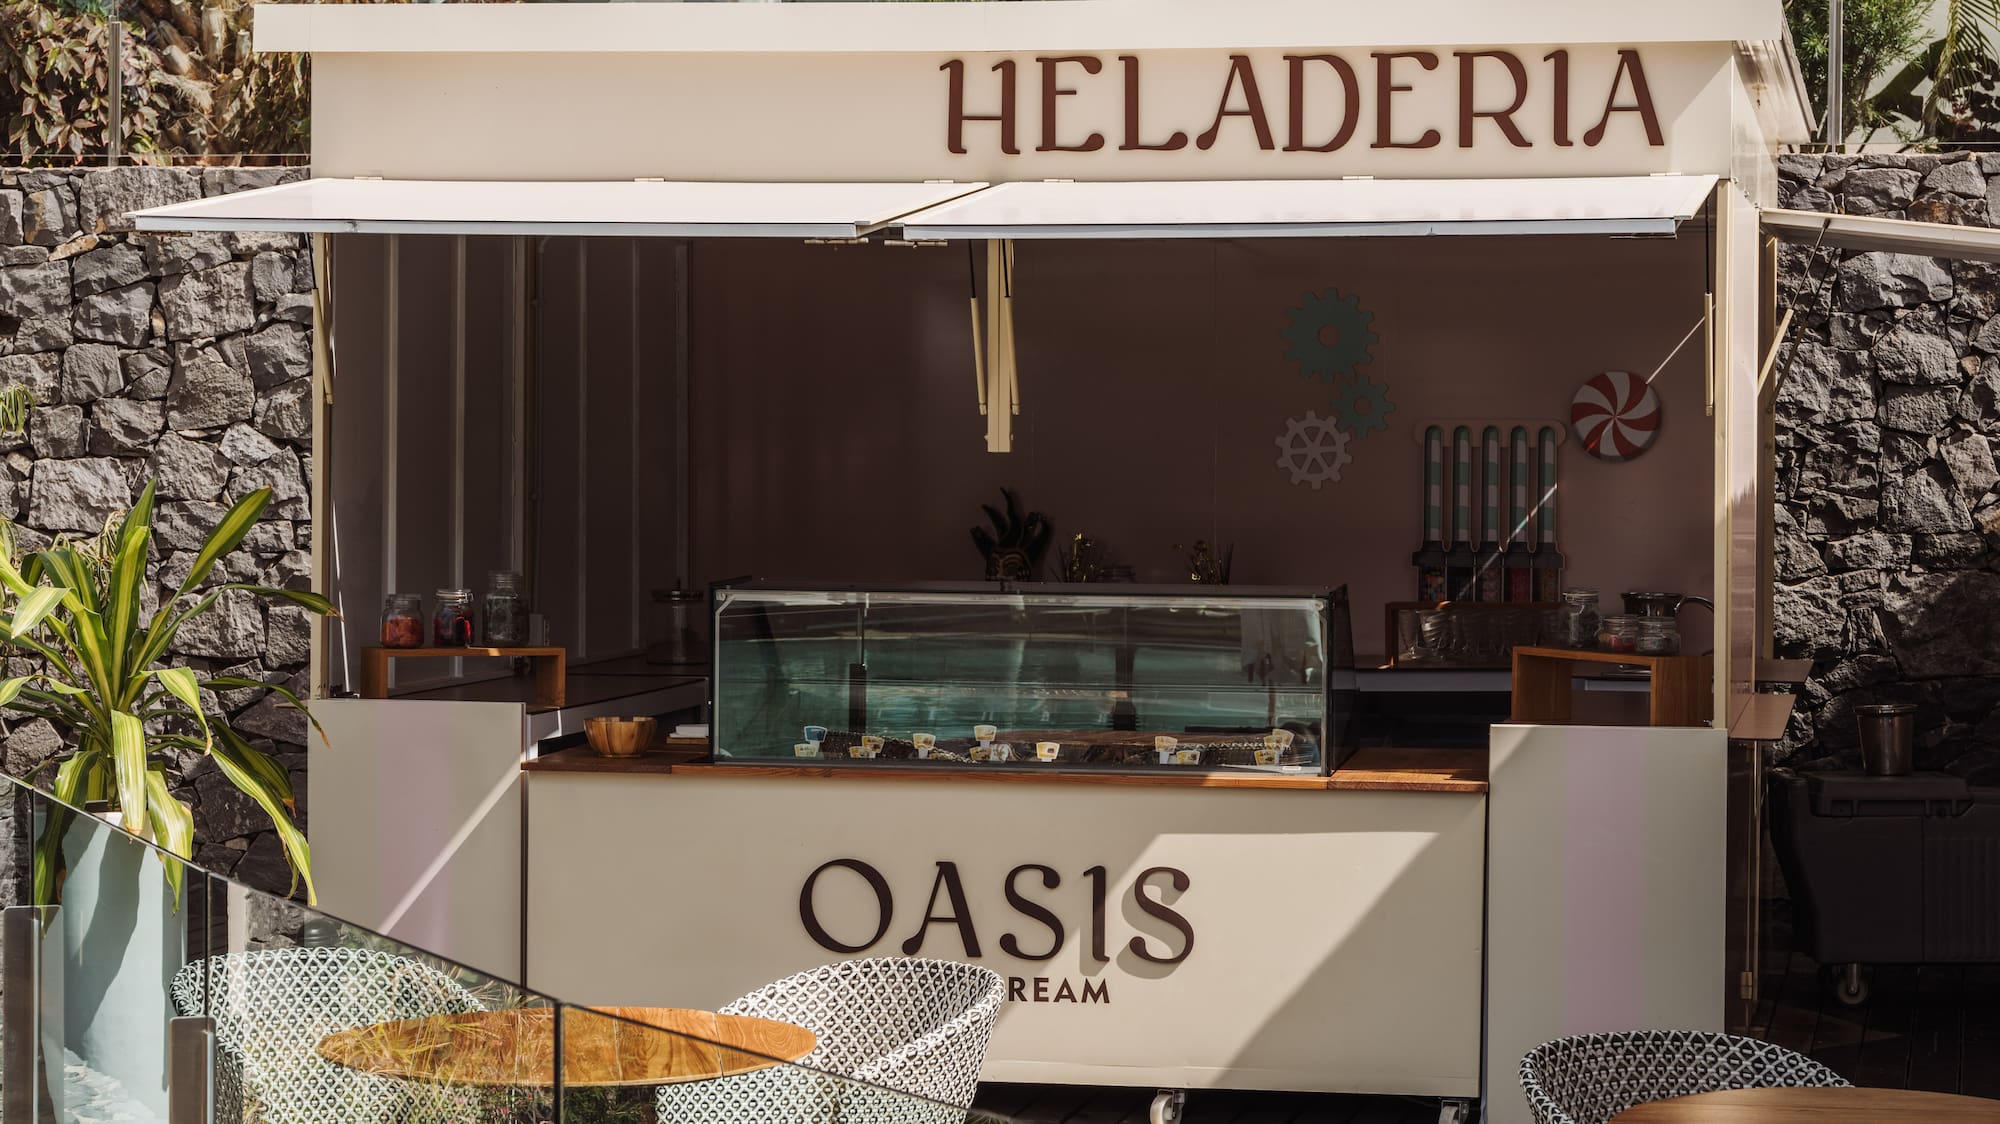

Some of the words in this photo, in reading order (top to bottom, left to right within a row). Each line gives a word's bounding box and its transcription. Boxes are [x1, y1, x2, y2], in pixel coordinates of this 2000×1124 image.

[939, 49, 1665, 154] HELADERIA
[799, 858, 1194, 965] OASIS
[1008, 976, 1110, 1004] REAM
